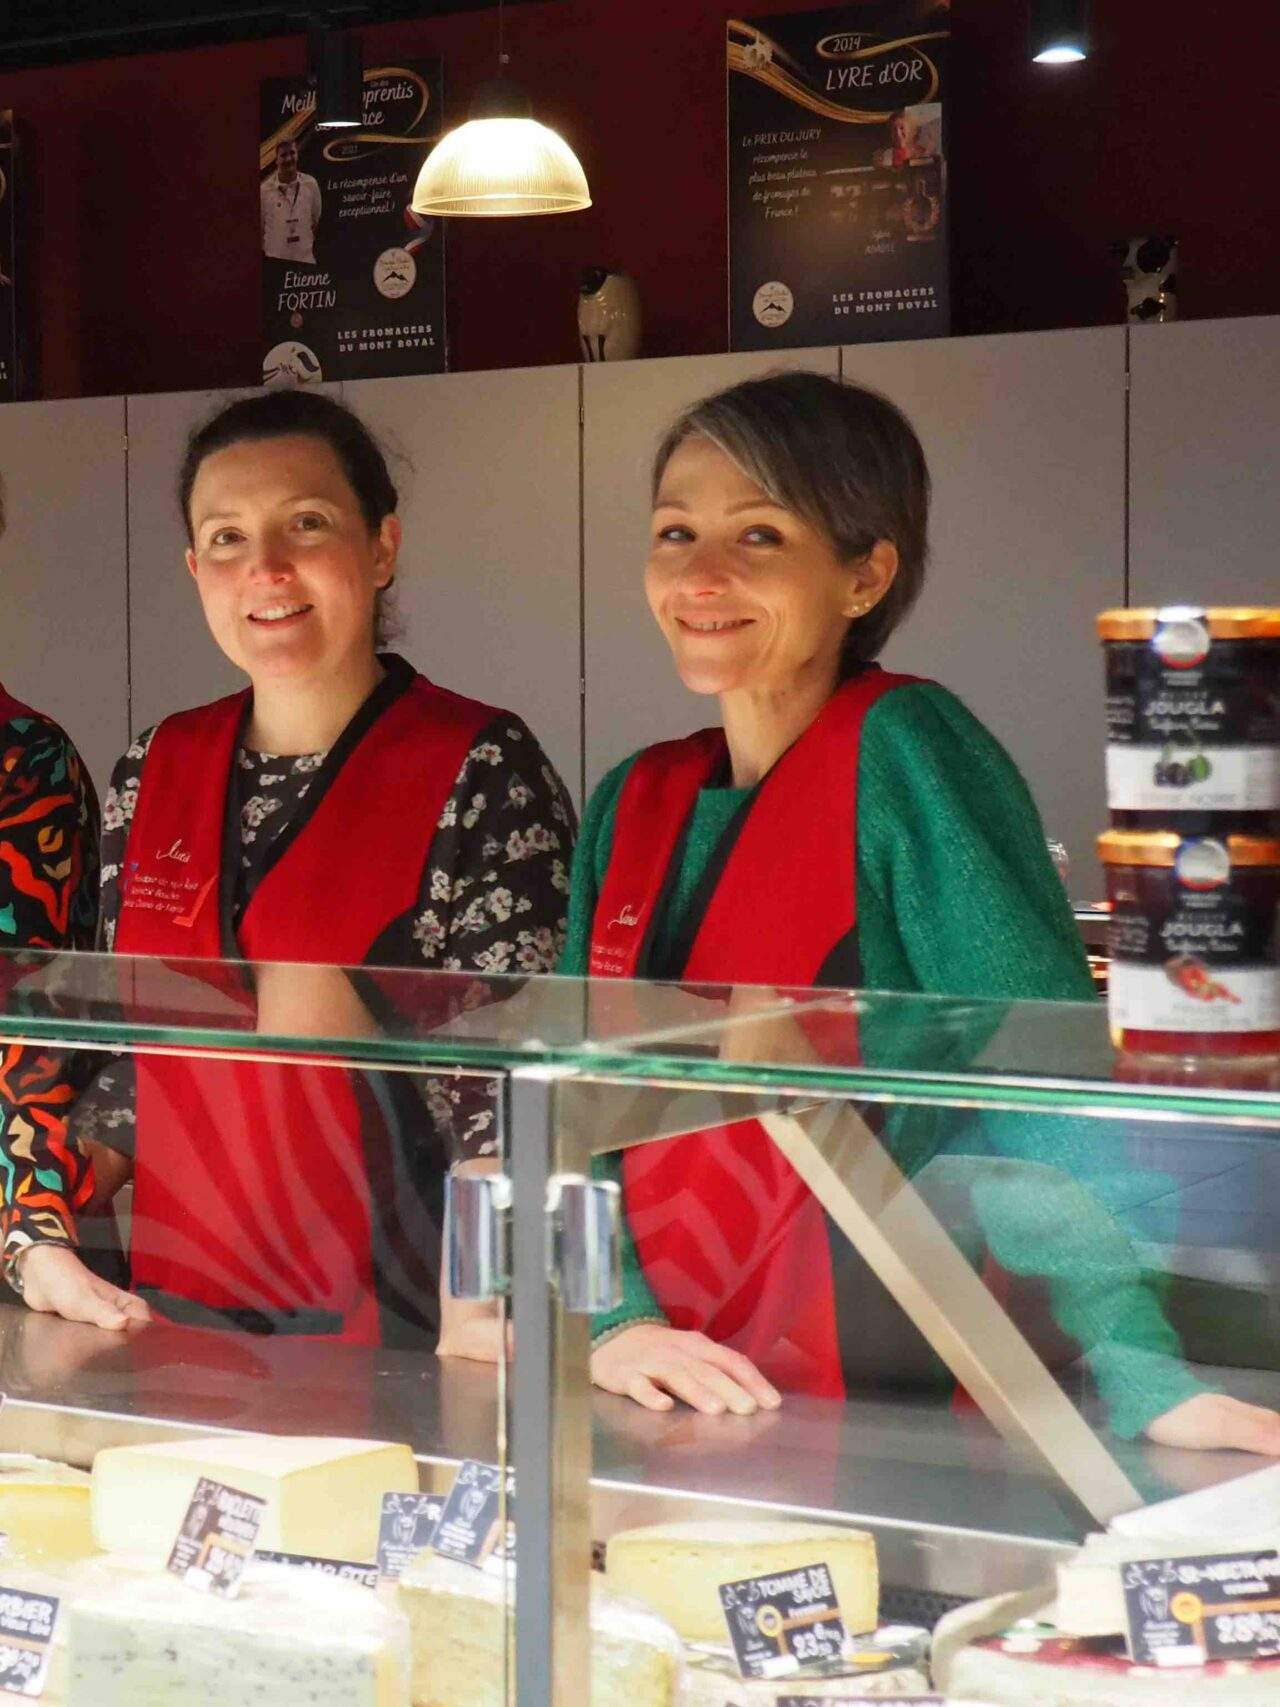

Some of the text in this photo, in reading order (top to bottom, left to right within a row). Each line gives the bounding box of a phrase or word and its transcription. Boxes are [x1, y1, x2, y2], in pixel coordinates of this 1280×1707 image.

[825, 60, 924, 91] LYRE d'OR
[277, 290, 337, 312] FORTIN
[859, 286, 935, 300] FROMAGERS
[855, 303, 892, 314] MONT
[897, 299, 938, 311] ROYAL
[337, 324, 433, 340] LES FROMAGERS
[359, 341, 393, 351] MONT
[397, 338, 436, 349] ROYAL
[758, 1572, 809, 1599] TOMME
